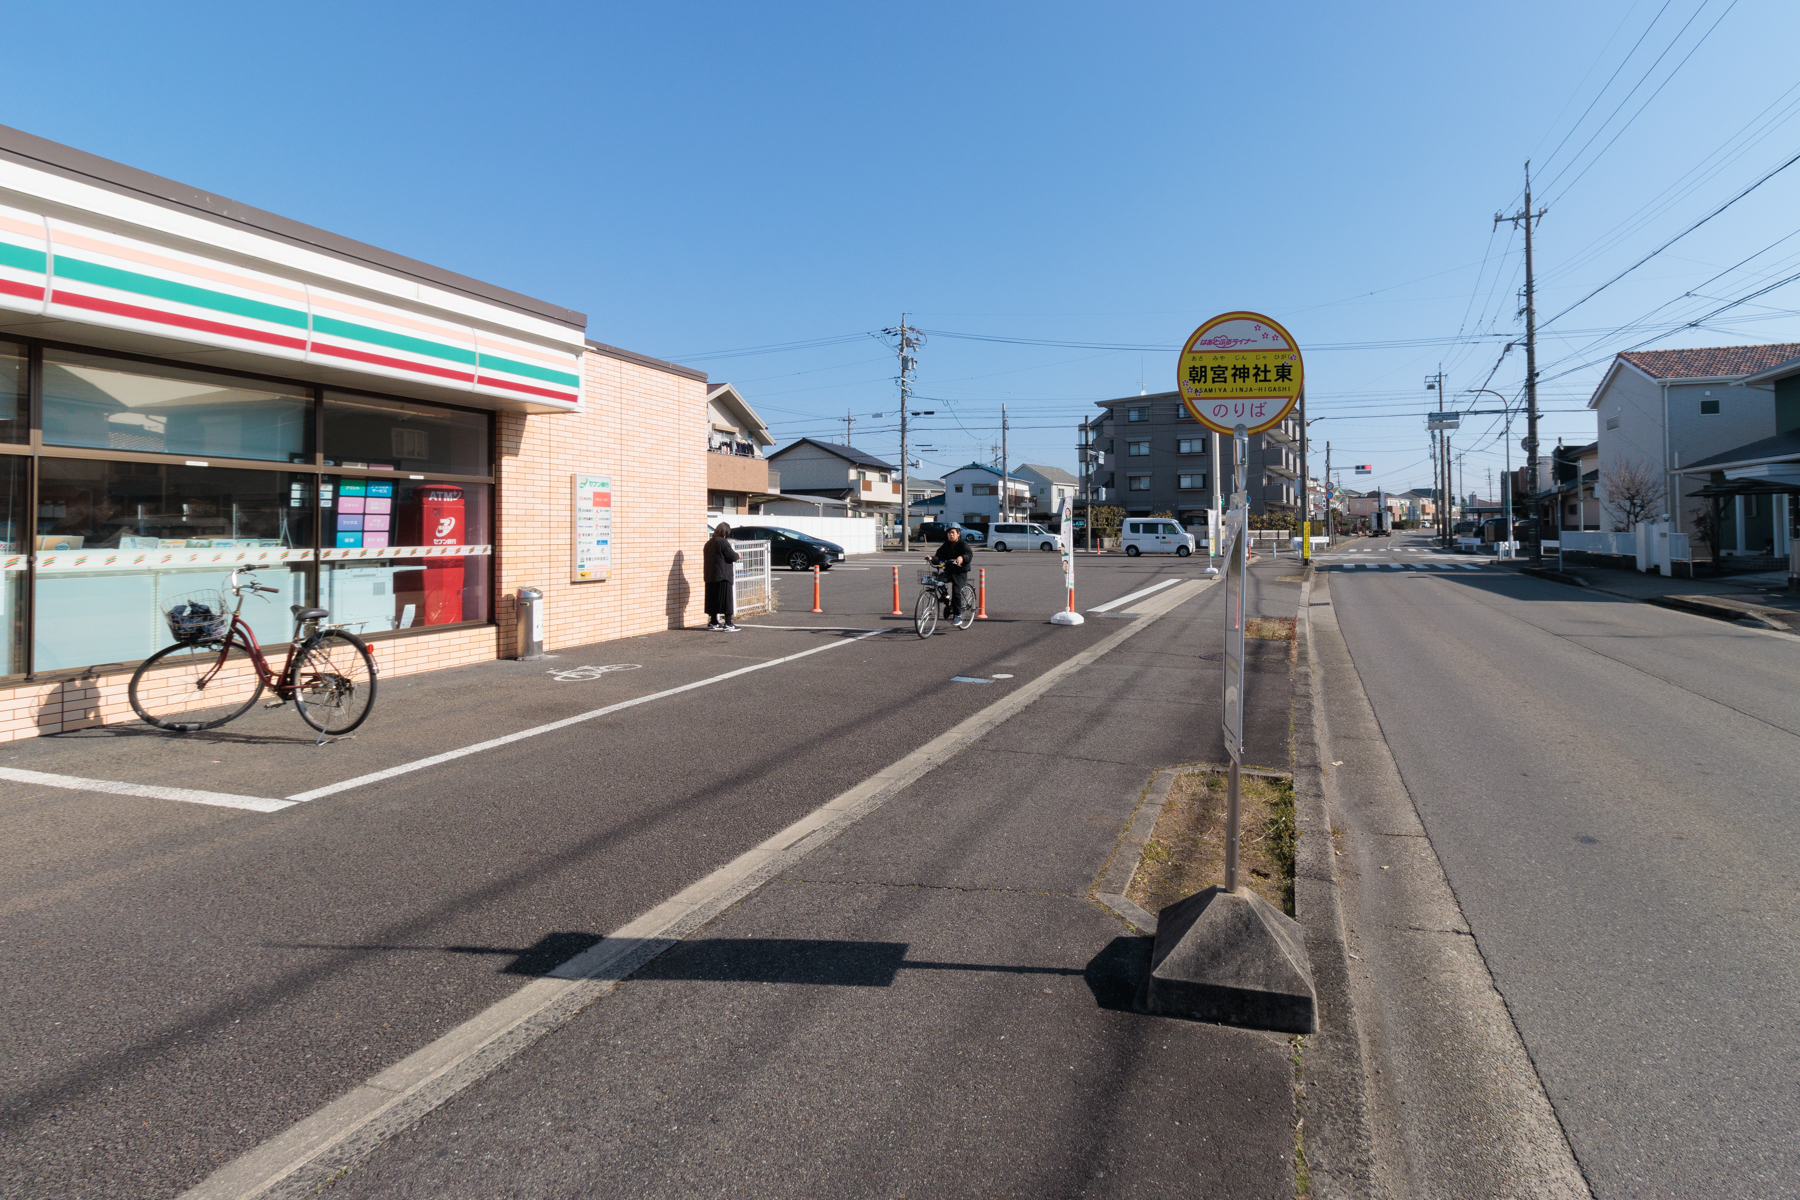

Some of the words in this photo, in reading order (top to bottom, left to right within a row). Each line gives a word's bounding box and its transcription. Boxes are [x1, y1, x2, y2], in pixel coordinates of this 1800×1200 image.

[1188, 364, 1293, 384] 朝宮神社東
[1213, 401, 1268, 418] のりば
